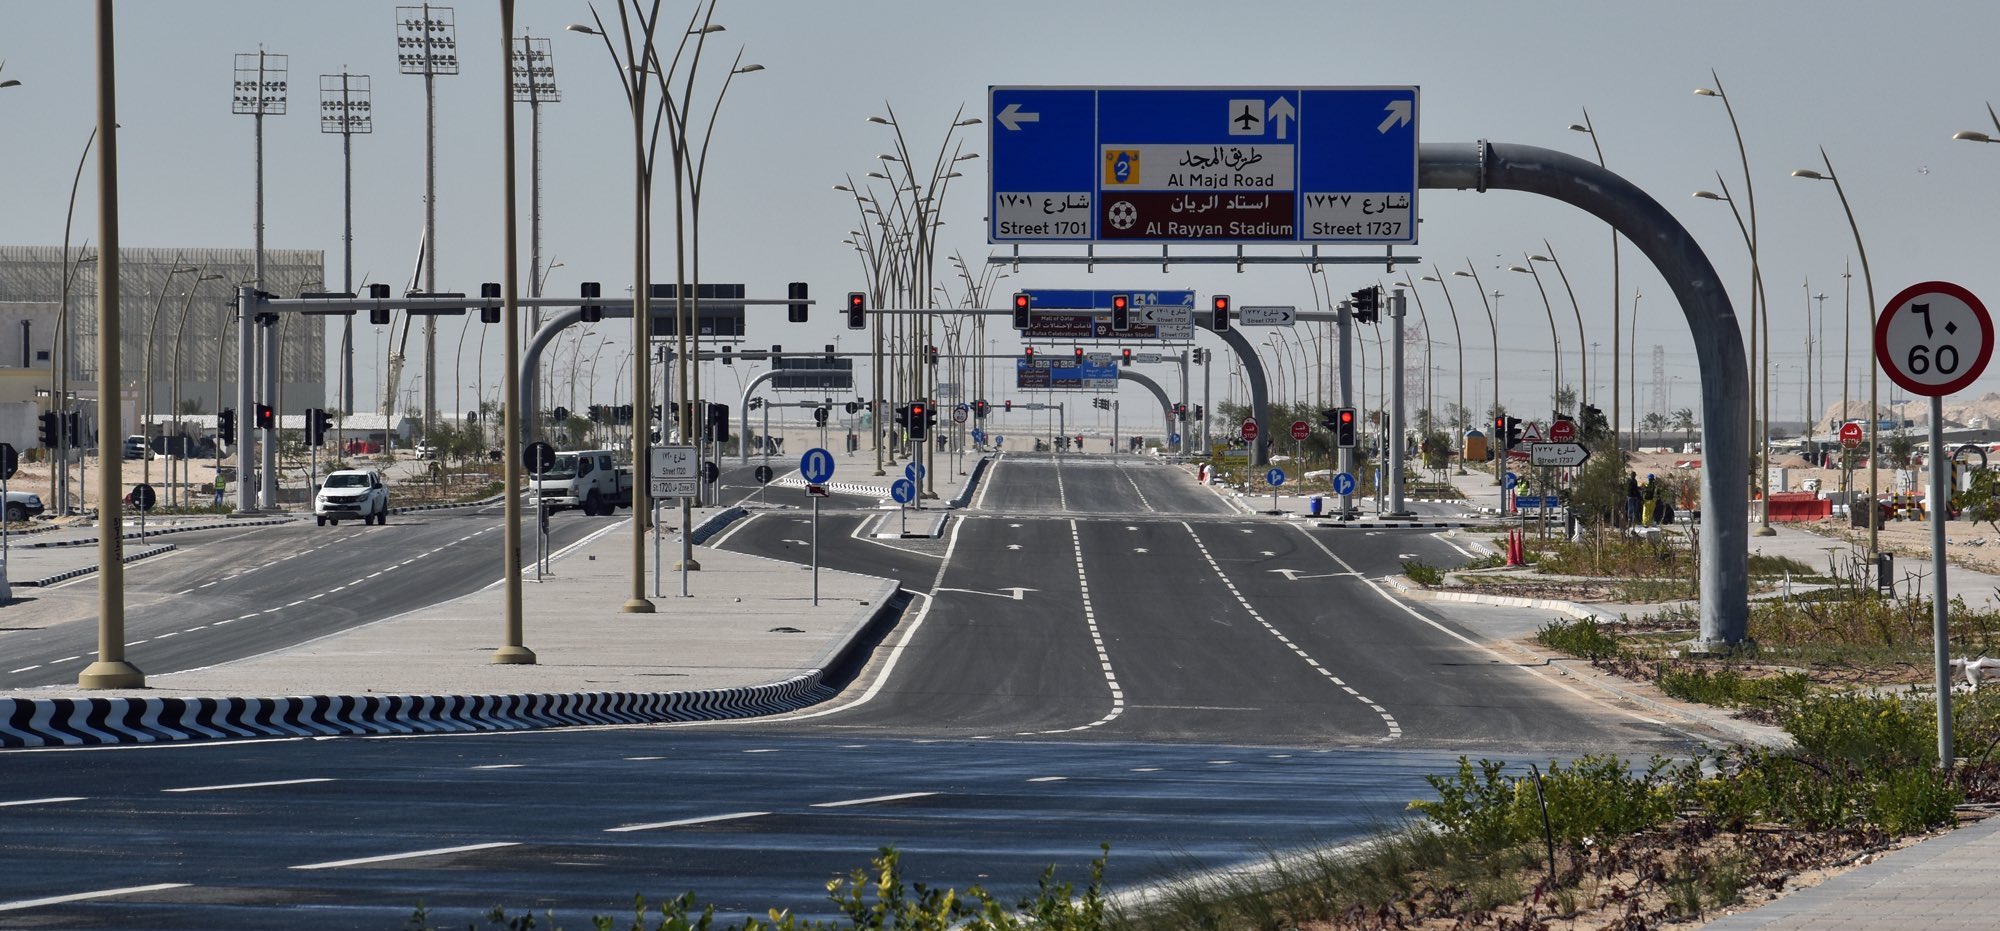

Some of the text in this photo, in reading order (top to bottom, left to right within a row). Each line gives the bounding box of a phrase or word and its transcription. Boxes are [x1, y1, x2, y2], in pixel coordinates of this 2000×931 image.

[1180, 146, 1262, 171] طريق المجد
[1117, 160, 1128, 176] 2
[1168, 174, 1274, 189] Al Majd Road
[1000, 194, 1090, 214] شارع ١٧٠١
[1170, 194, 1269, 214] استاد الريان
[1306, 194, 1409, 214] شارع ١٧٣٧
[1000, 221, 1086, 234] Street 1701
[1146, 221, 1293, 238] Al Rayyan Stadium
[1312, 222, 1401, 235] Street 1737
[1910, 303, 1958, 340] ٦٠
[1908, 344, 1959, 375] 60
[1557, 447, 1576, 455] شارع
[660, 482, 672, 492] 1720
